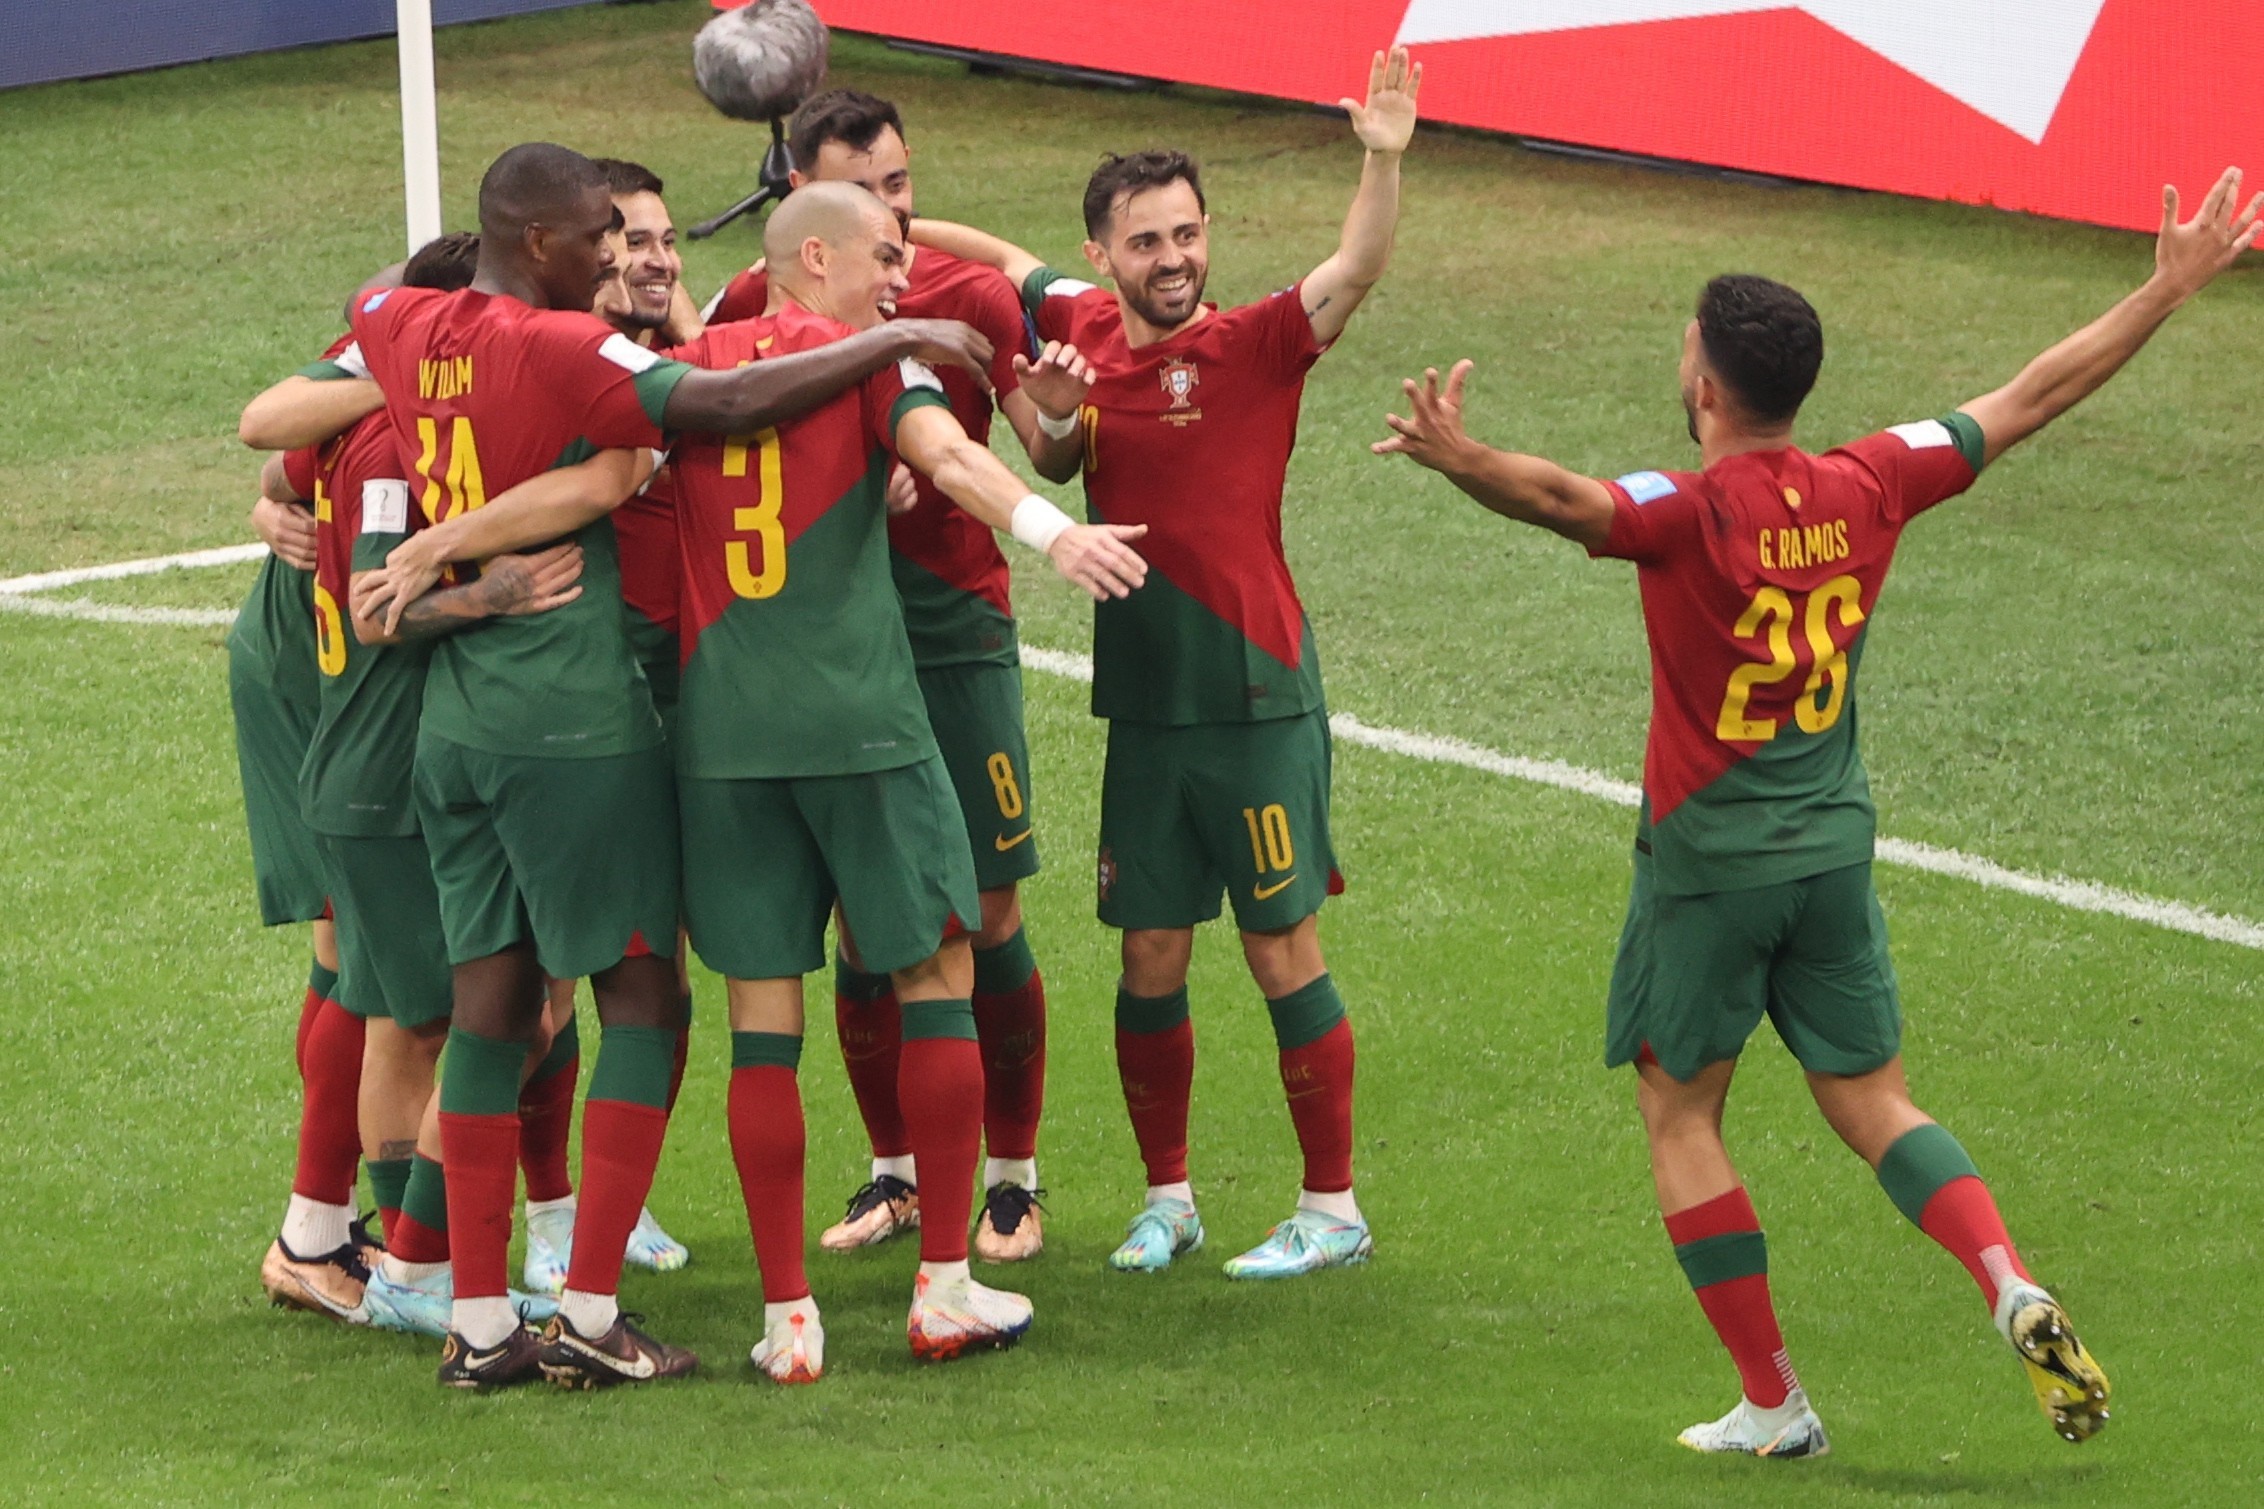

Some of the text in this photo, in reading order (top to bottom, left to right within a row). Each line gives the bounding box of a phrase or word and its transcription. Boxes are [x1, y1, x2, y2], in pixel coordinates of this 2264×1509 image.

[414, 416, 486, 526] 14
[722, 426, 788, 600] 3
[1715, 574, 1866, 742] 26
[987, 751, 1024, 820] 8
[1242, 802, 1296, 874] 10
